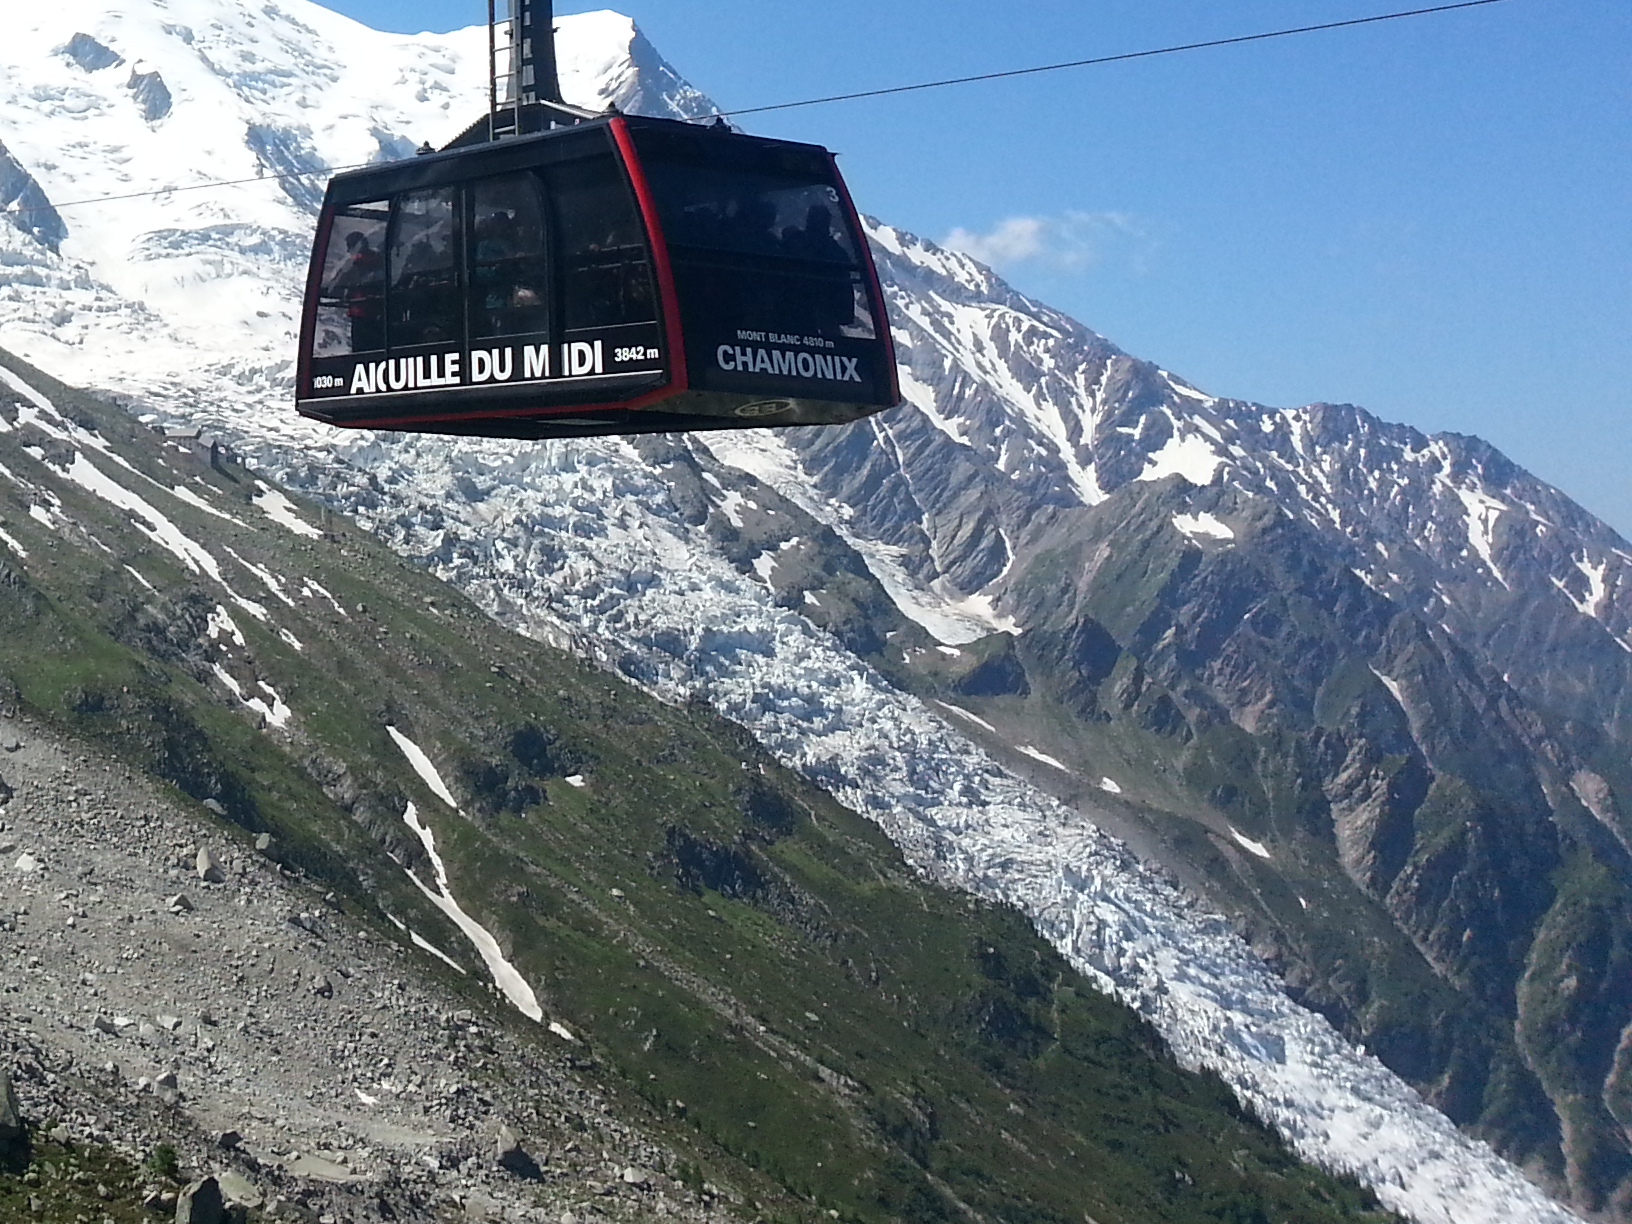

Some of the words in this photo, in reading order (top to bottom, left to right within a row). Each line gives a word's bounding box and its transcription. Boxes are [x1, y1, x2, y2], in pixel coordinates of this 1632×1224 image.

[826, 186, 839, 202] 3
[737, 329, 766, 342] MONT
[768, 332, 801, 345] BLANC
[803, 336, 824, 347] 4810
[312, 375, 333, 389] 1030
[334, 377, 344, 387] m
[471, 347, 513, 382] DU
[614, 345, 645, 362] 3842
[646, 348, 659, 359] m
[717, 344, 862, 383] CHAMONIX
